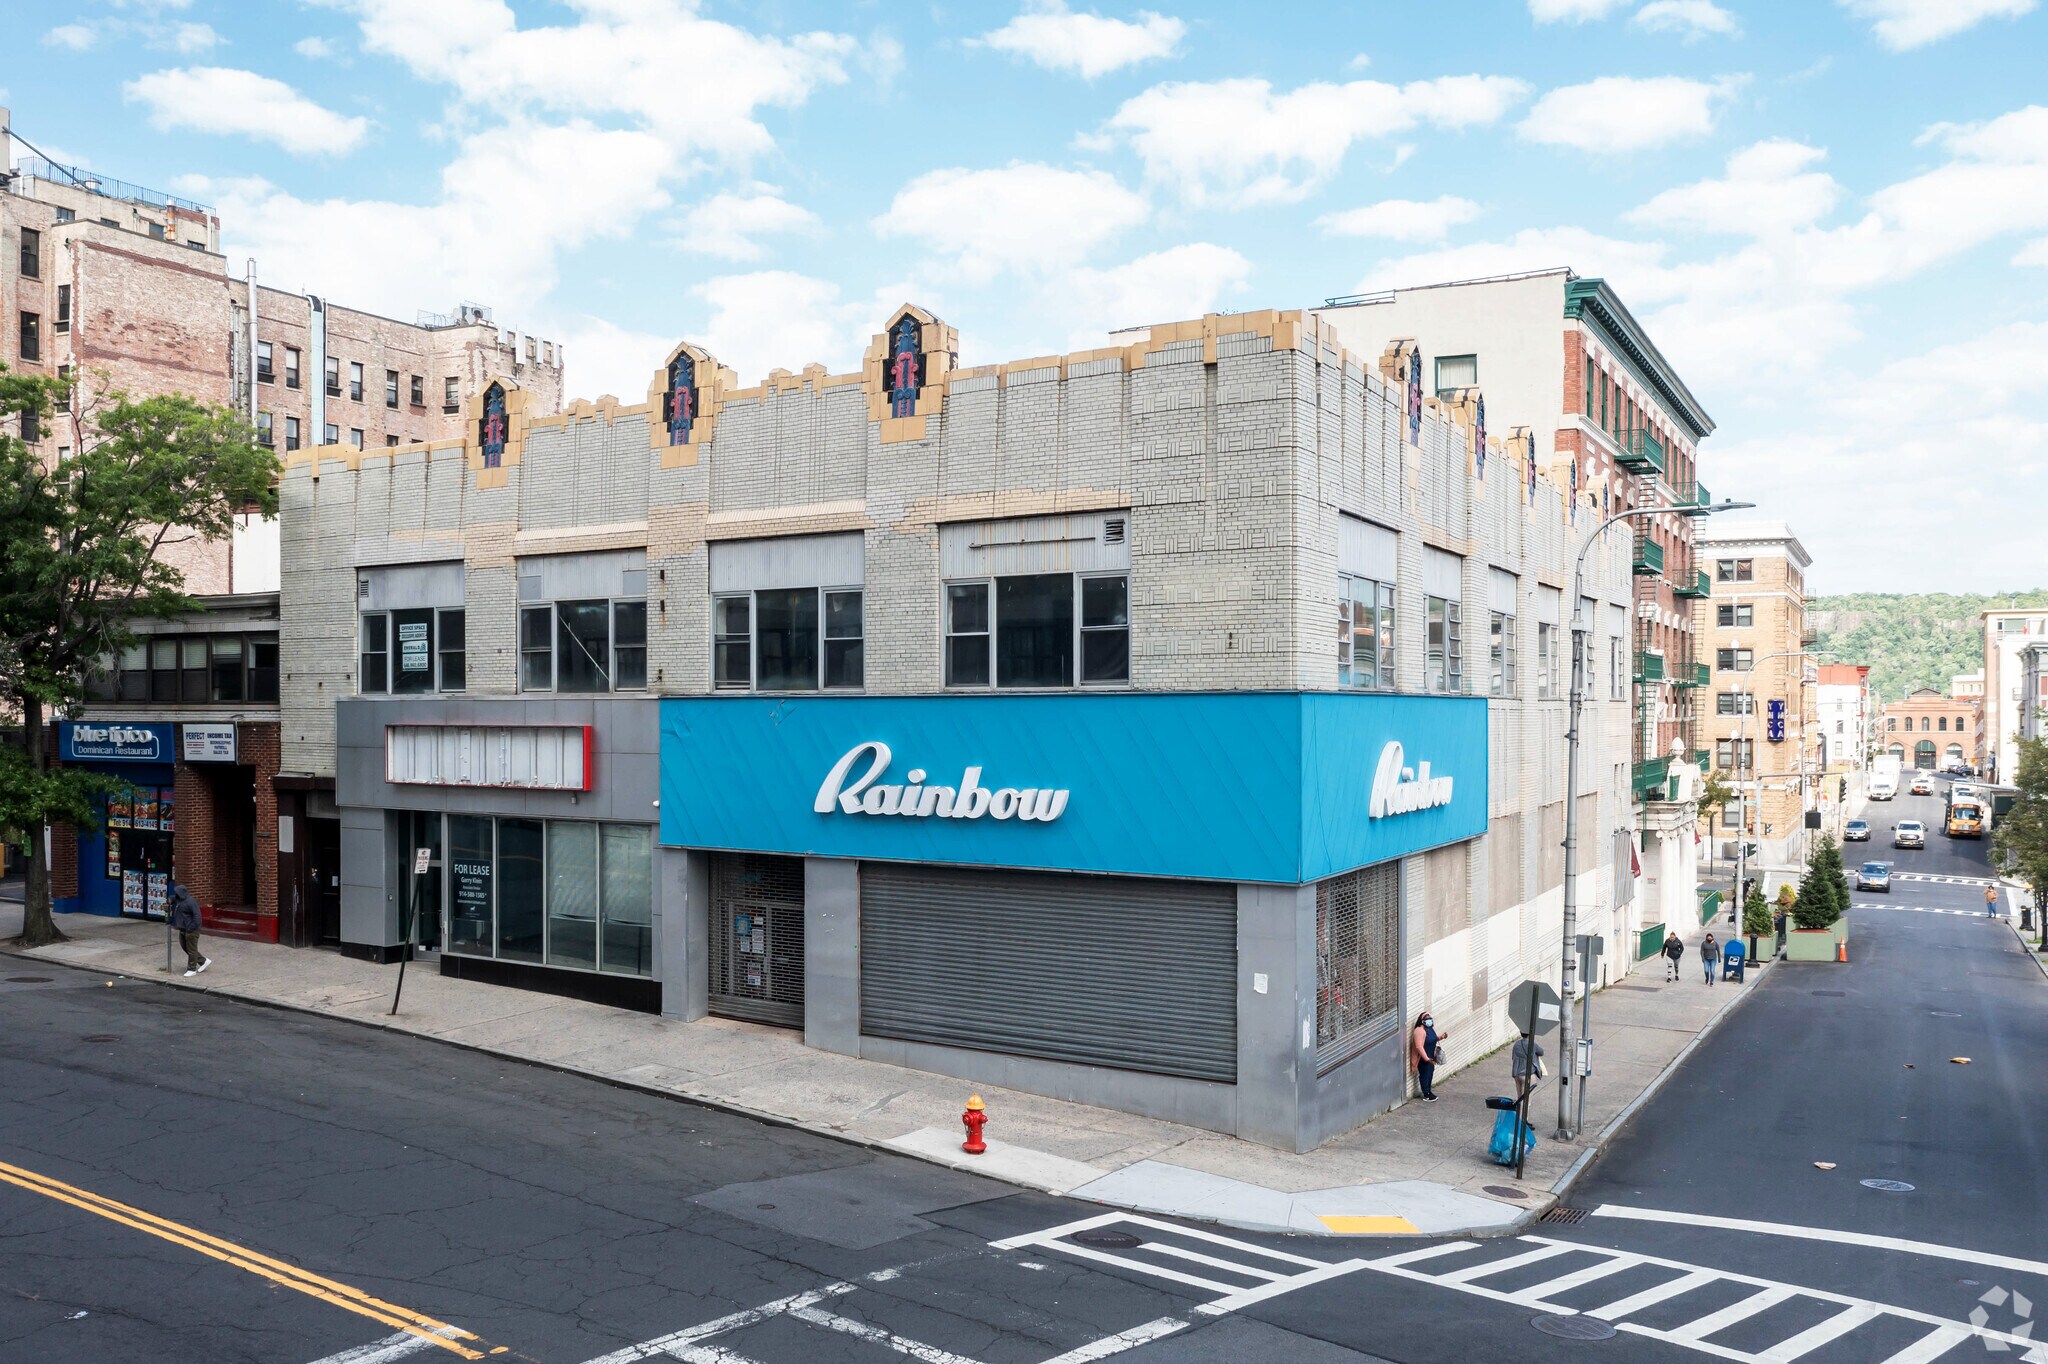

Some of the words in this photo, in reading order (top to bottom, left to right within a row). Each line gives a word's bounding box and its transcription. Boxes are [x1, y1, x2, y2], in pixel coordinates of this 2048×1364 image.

[73, 725, 108, 742] blue
[185, 732, 205, 740] PERFECT
[78, 746, 113, 754] Dominican
[115, 747, 153, 755] Restaurant
[813, 741, 1070, 822] Rainbow
[454, 864, 468, 874] FOR
[469, 864, 490, 876] LEASE
